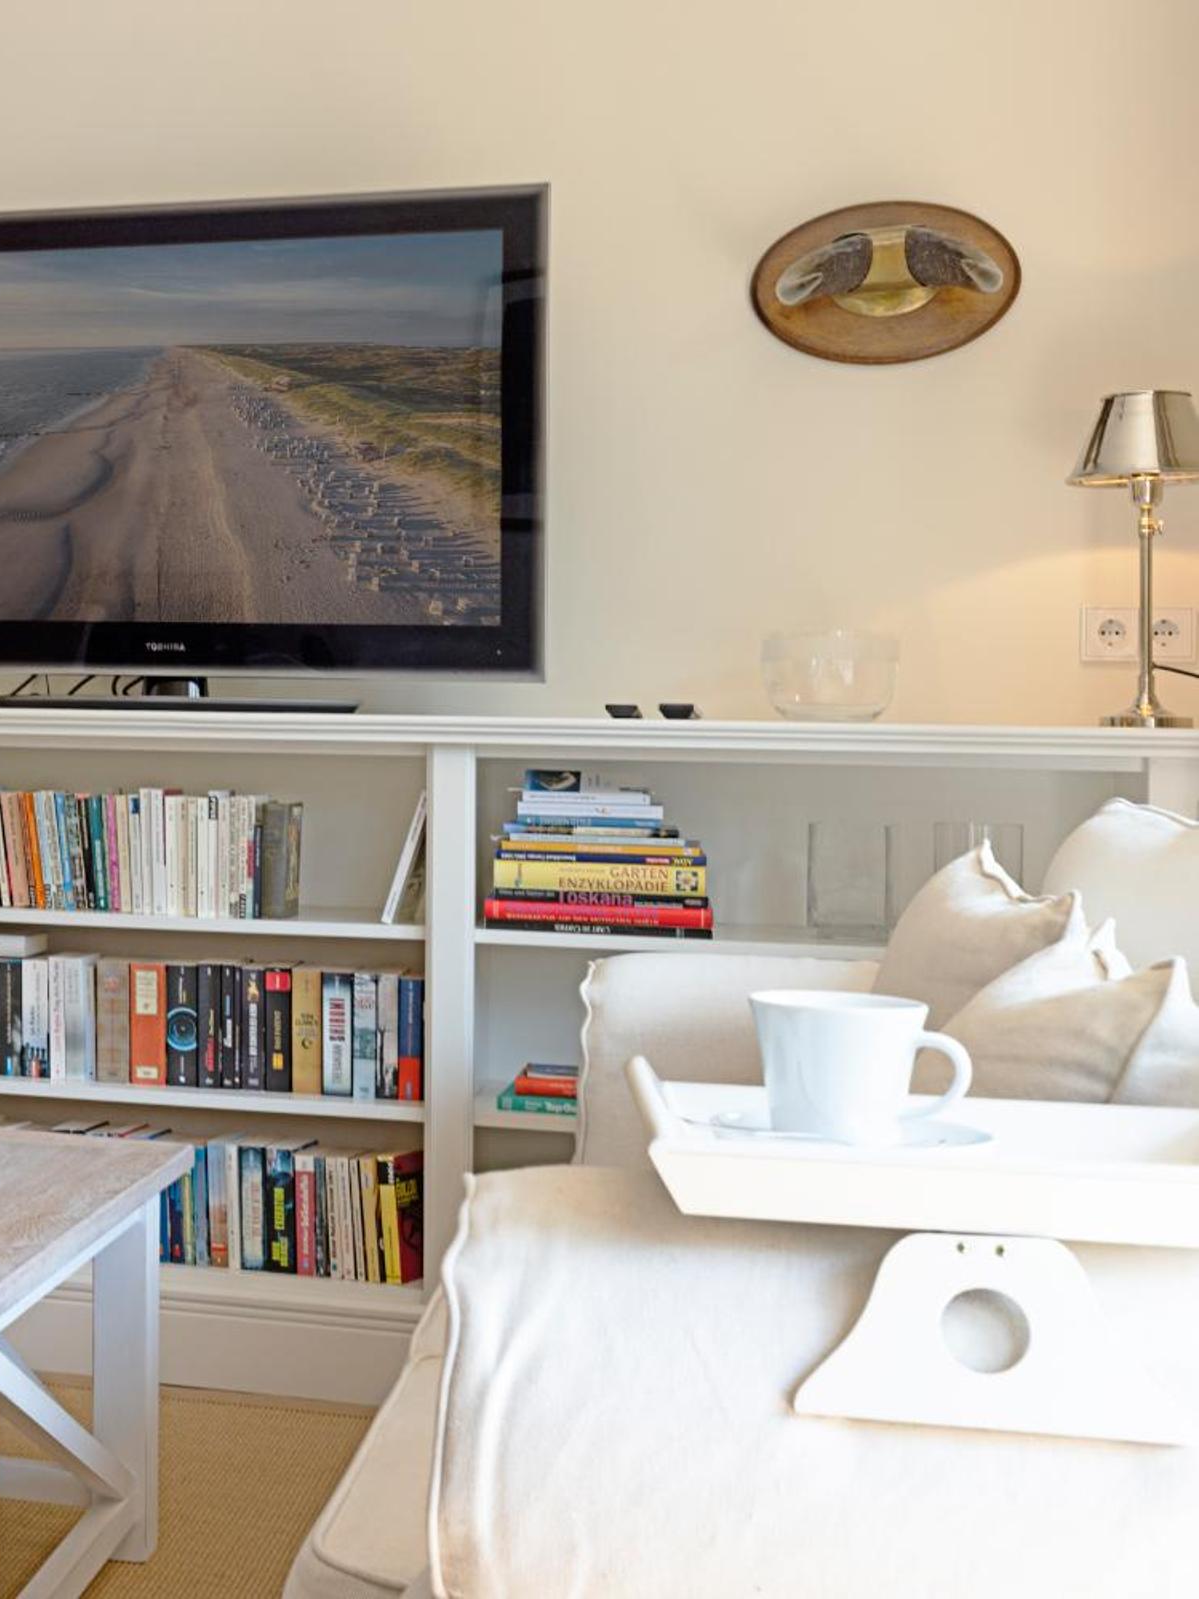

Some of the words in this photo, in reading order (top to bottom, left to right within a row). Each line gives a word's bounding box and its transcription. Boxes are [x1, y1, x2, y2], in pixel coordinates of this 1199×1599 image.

[145, 642, 186, 651] TOSHIBA
[609, 866, 669, 879] GARTEN
[558, 890, 633, 905] Toskana
[329, 998, 345, 1042] SHIBUMI
